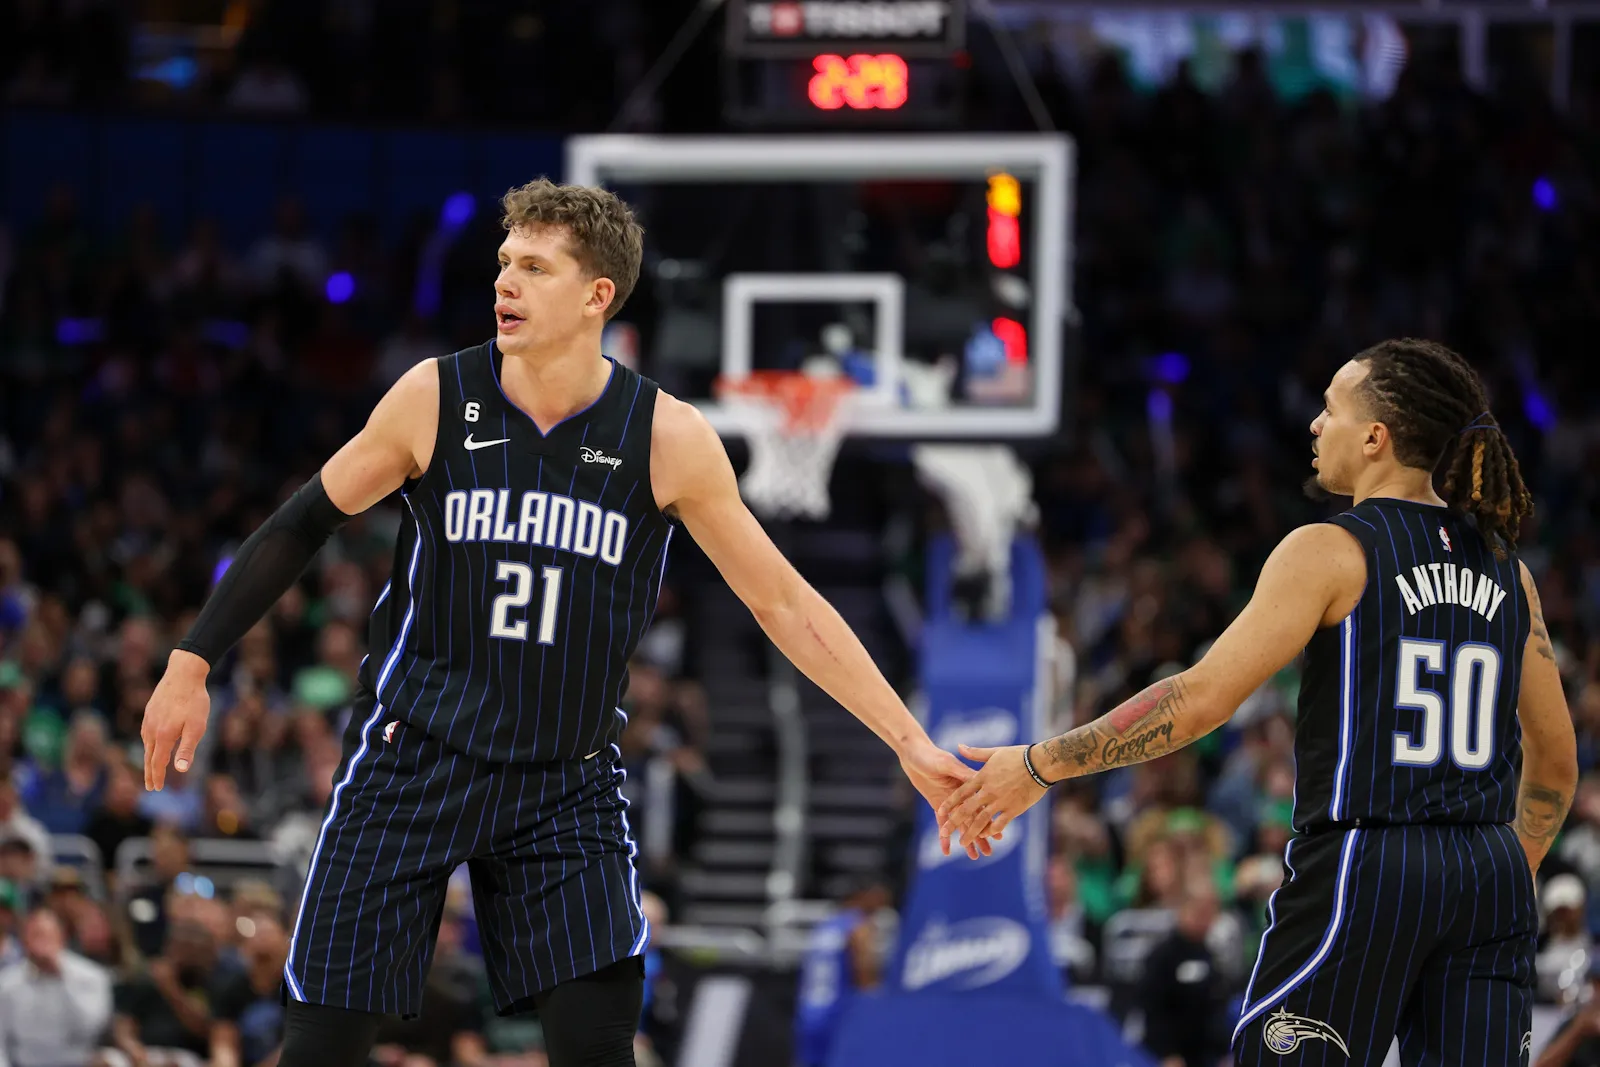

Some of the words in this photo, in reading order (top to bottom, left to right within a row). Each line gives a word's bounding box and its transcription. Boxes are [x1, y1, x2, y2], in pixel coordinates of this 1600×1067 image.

[464, 401, 481, 423] 6
[445, 488, 628, 566] ORLANDO
[488, 560, 565, 646] 21
[1394, 562, 1507, 623] ANTHONY
[1391, 635, 1503, 772] 50
[1102, 720, 1175, 766] Gregory
